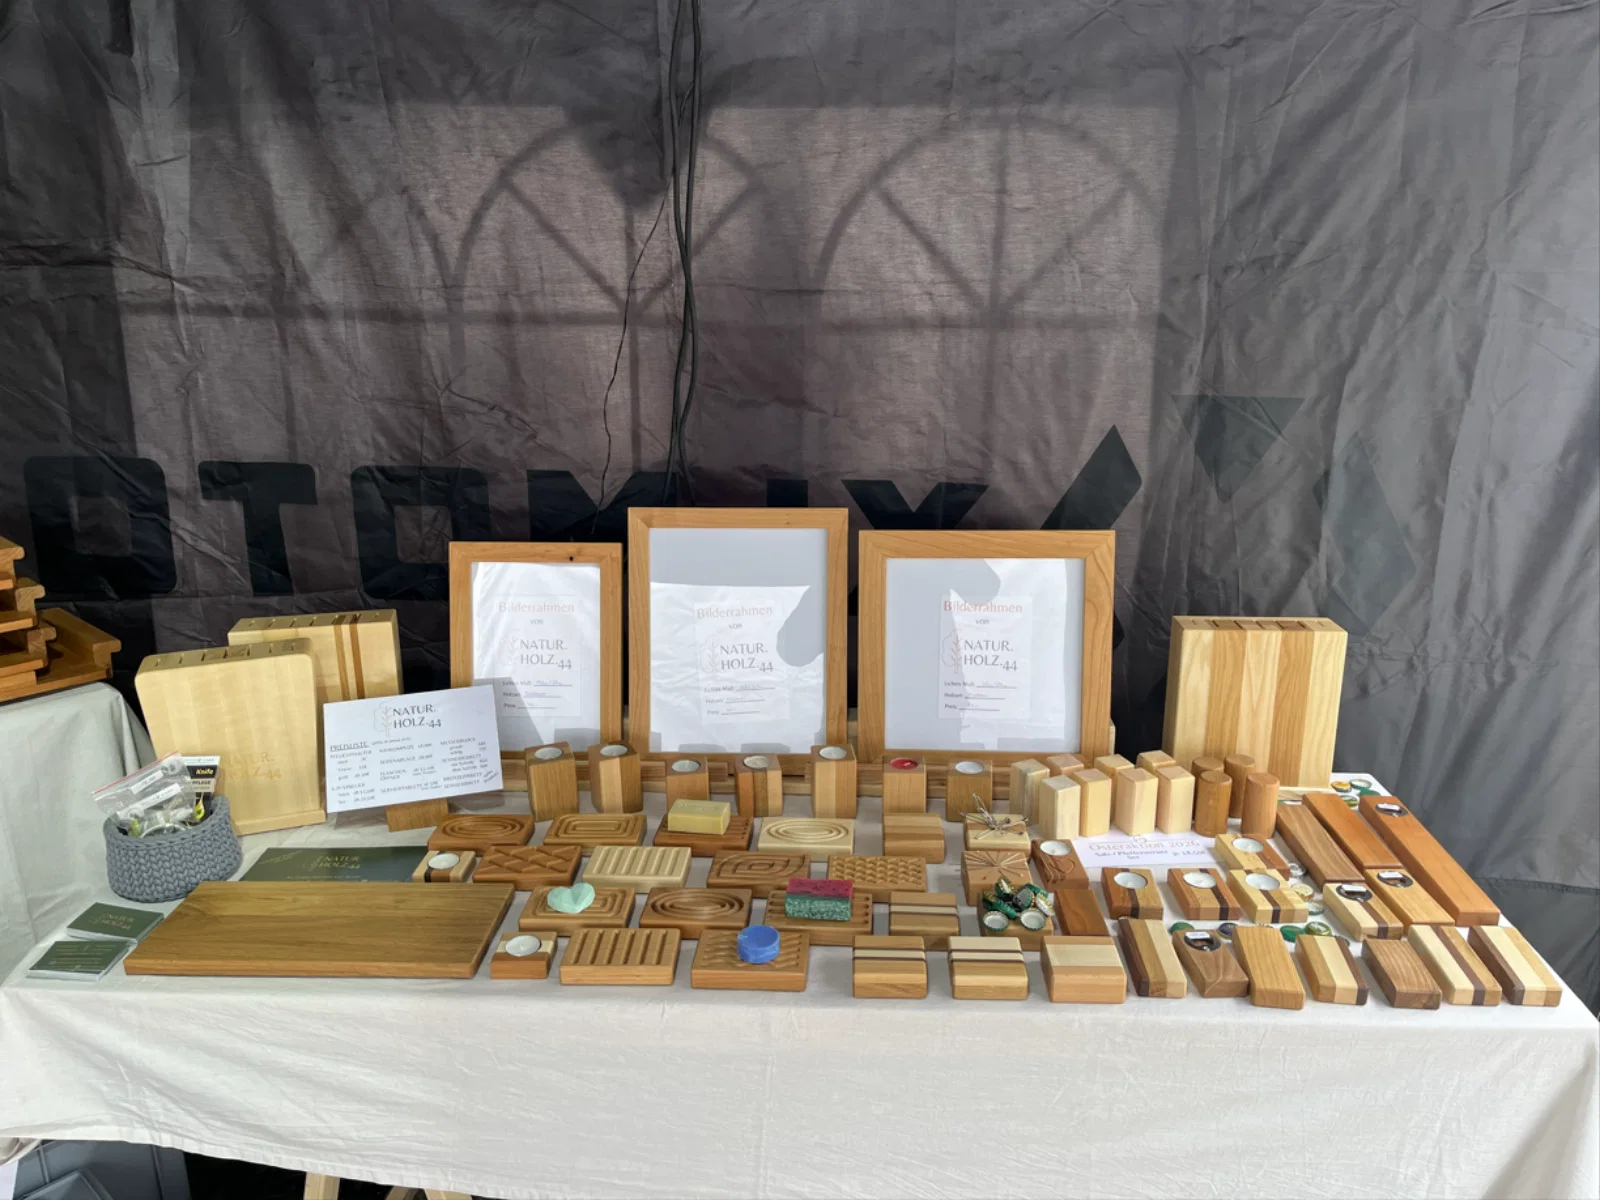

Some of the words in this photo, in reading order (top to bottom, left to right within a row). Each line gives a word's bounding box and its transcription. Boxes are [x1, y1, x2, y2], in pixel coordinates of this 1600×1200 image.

[498, 601, 575, 613] Bilderrahmen
[696, 605, 773, 620] Bilderrahmen
[944, 600, 1023, 614] Bilderrahmen
[519, 638, 568, 651] NATUR.
[719, 642, 769, 655] NATUR.
[963, 639, 1014, 652] NATUR.
[393, 703, 437, 717] NATUR.
[1088, 842, 1165, 852] Osteraktion
